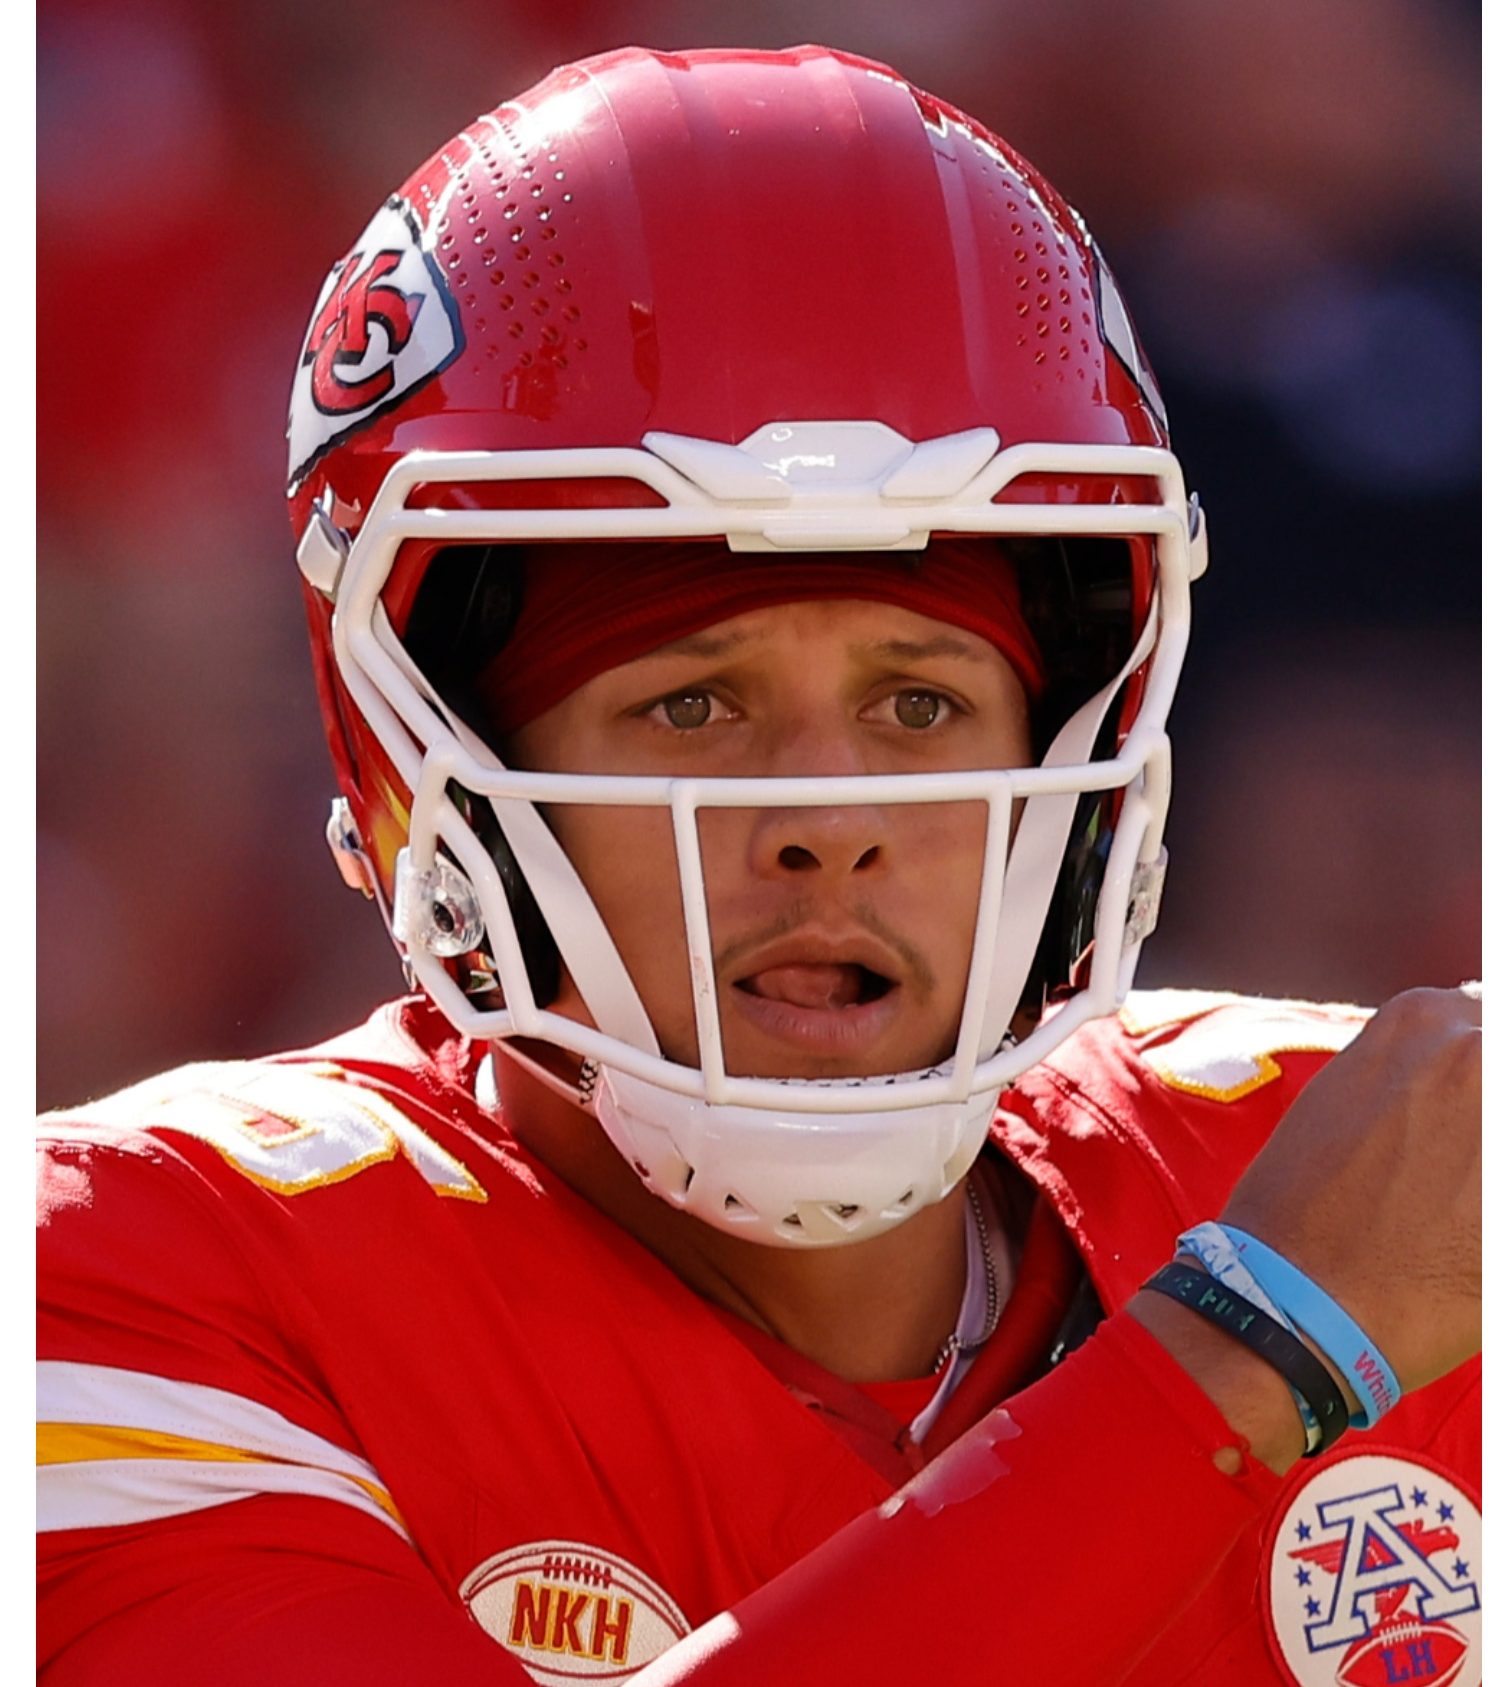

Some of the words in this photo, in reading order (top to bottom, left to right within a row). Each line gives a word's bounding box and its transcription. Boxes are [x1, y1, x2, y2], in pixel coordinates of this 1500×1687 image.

[1304, 1484, 1481, 1653] A
[508, 1578, 635, 1666] NKH
[1378, 1640, 1437, 1684] LH
